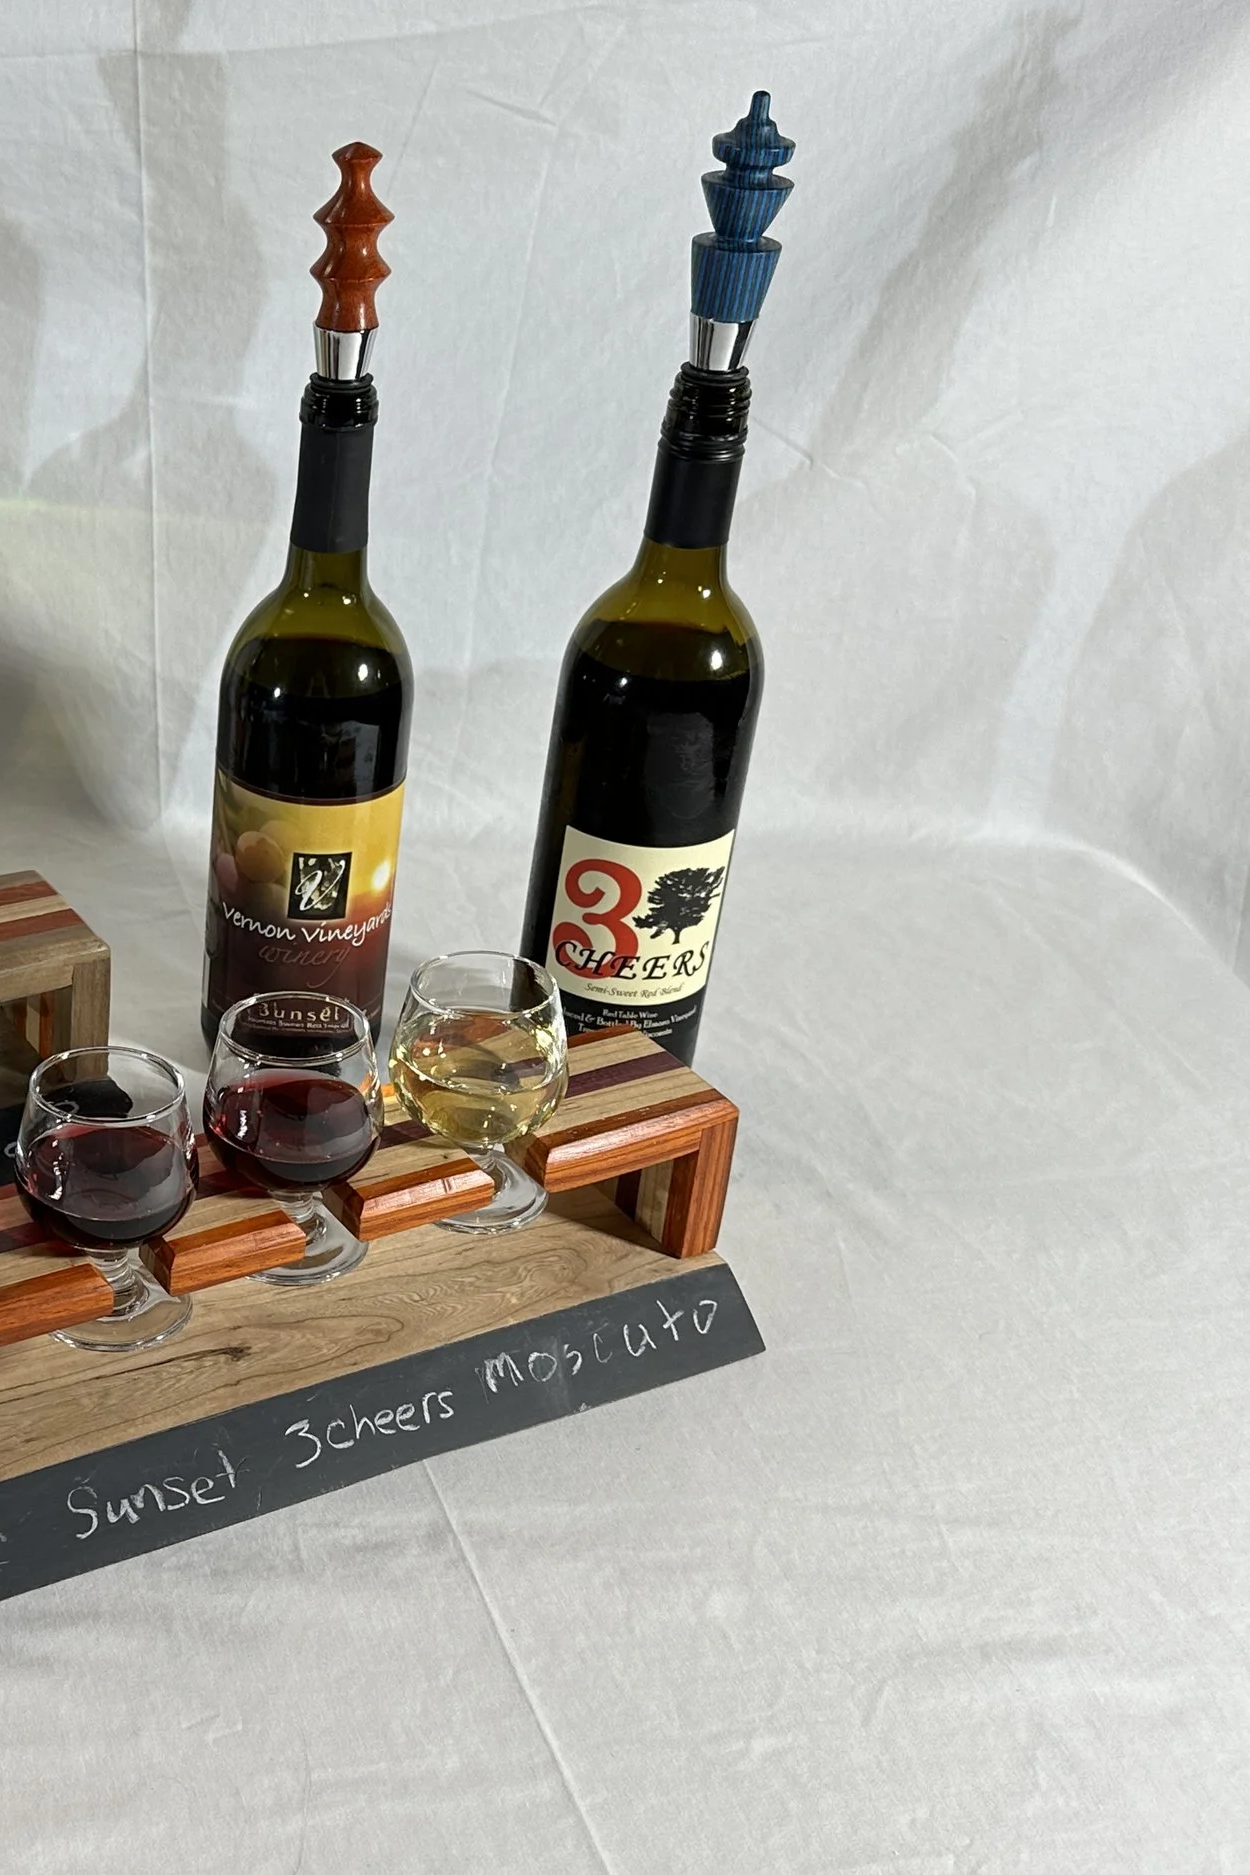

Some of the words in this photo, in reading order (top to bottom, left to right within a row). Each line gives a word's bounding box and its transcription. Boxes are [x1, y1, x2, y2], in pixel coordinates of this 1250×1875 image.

[553, 858, 643, 979] 3
[258, 944, 352, 989] winery
[555, 940, 711, 981] CHEERS
[584, 982, 638, 998] Semi-Sweet
[66, 1448, 250, 1540] Sunset
